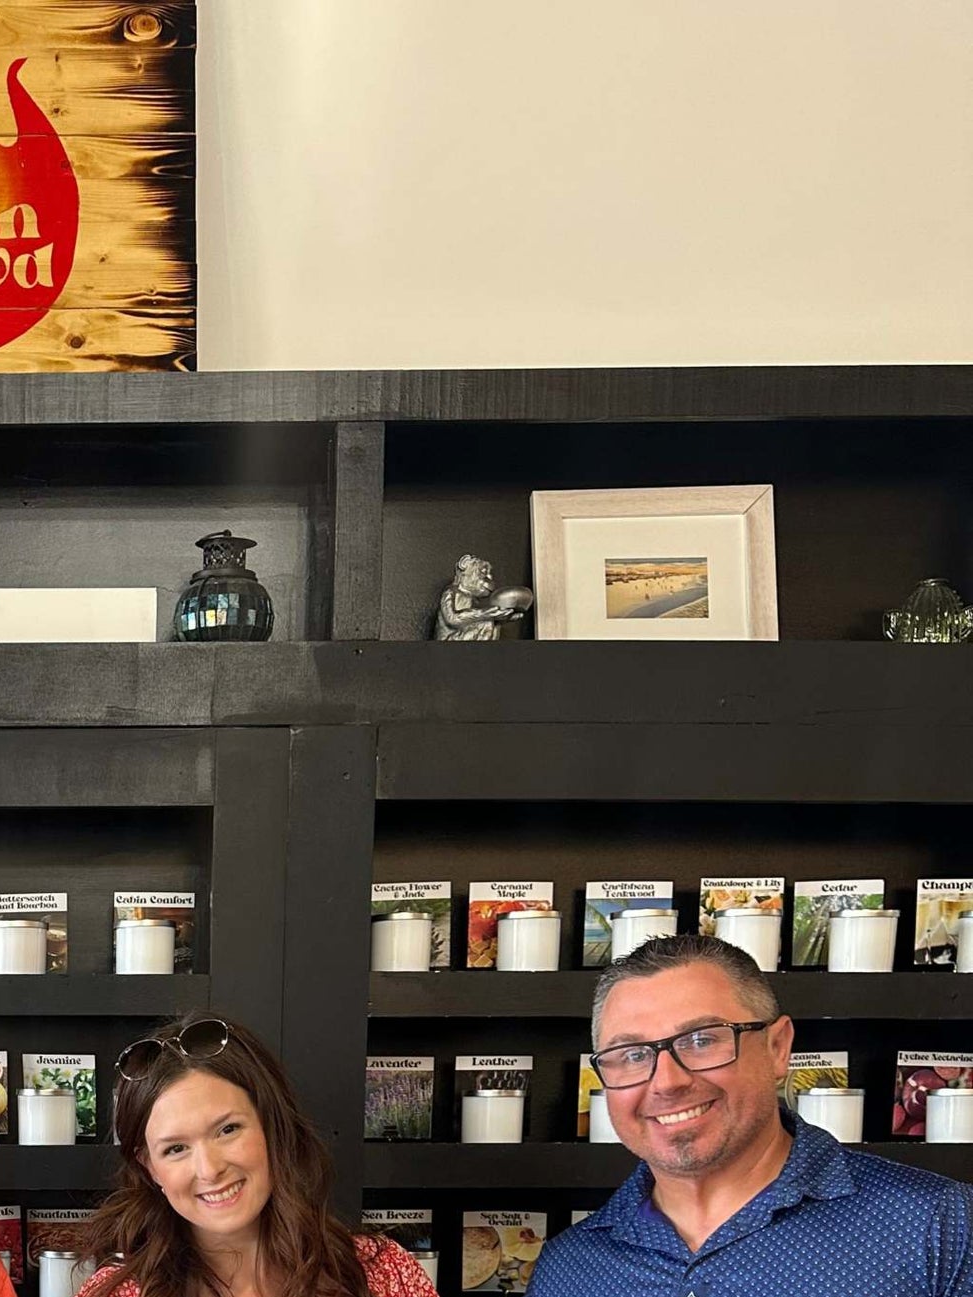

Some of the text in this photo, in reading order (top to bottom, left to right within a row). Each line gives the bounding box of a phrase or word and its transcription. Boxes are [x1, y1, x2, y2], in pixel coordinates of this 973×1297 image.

[373, 883, 443, 893] Cactus Flower
[601, 883, 655, 891] Caribbean
[703, 879, 754, 889] Cantaloupe
[764, 879, 782, 888] Lily
[821, 883, 858, 892] Cedar
[497, 889, 526, 898] Maple
[604, 890, 656, 898] Teakwood
[116, 895, 193, 904] Cabin Comfort
[17, 902, 58, 910] Bourbon
[36, 1055, 82, 1065] Jasmine
[472, 1057, 518, 1066] Leather
[899, 1053, 929, 1063] Lychee
[362, 1210, 425, 1219] Sea Breeze
